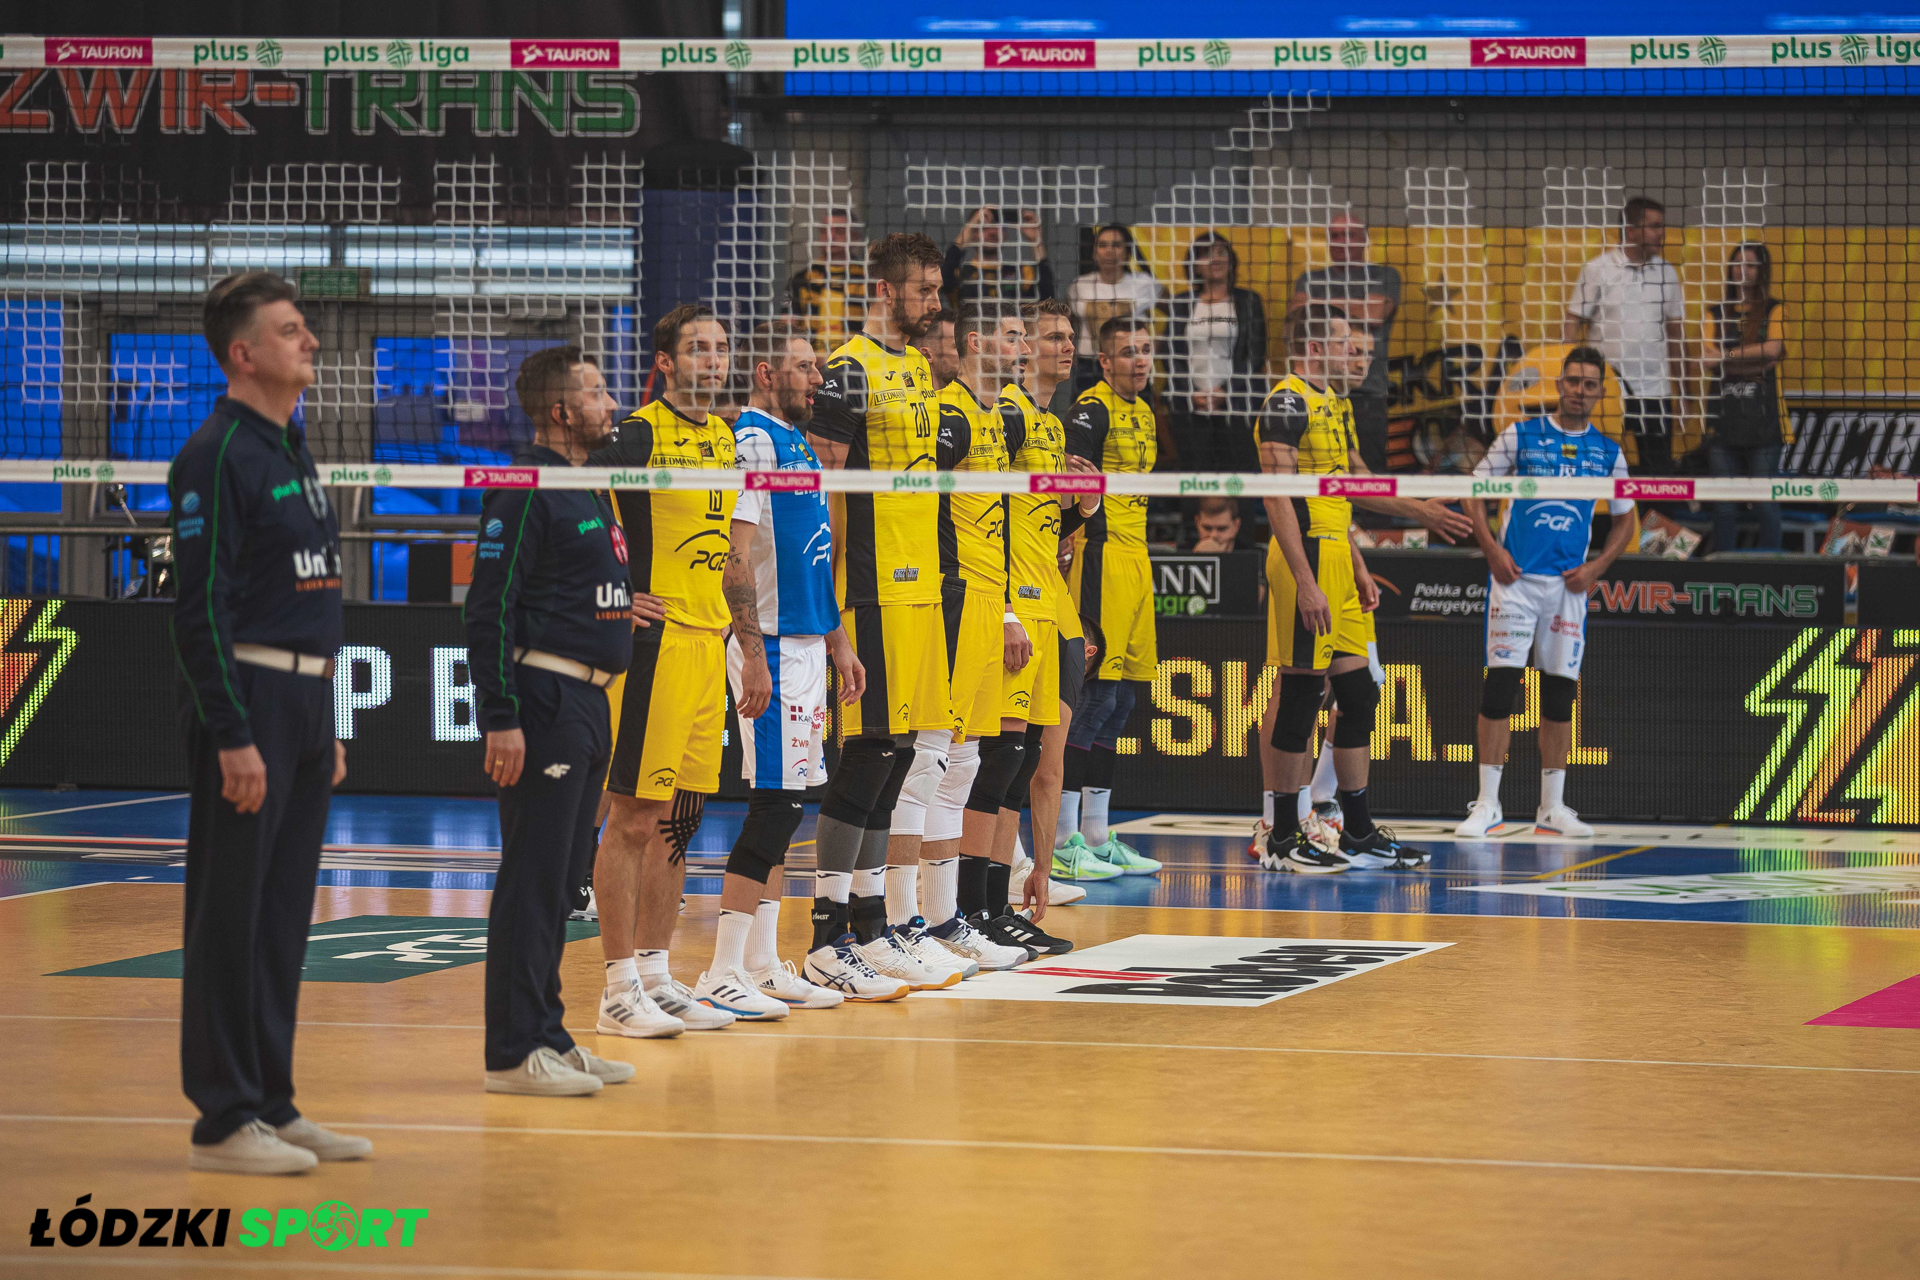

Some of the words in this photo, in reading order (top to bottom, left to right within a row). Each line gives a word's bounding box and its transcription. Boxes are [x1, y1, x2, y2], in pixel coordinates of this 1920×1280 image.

[79, 45, 143, 59] TAURON
[193, 39, 249, 63] plus
[324, 40, 379, 66] plus
[419, 41, 469, 67] liga
[544, 47, 611, 62] TAURON
[661, 41, 718, 67] plus
[793, 41, 850, 67] plus
[891, 41, 942, 67] liga
[1020, 47, 1087, 62] TAURON
[1138, 40, 1195, 67] plus
[1273, 40, 1332, 67] plus
[1375, 39, 1427, 66] liga
[1507, 45, 1576, 60] TAURON
[1630, 37, 1690, 65] plus
[1771, 37, 1832, 65] plus
[921, 388, 937, 401] plus
[910, 402, 930, 438] 20
[53, 464, 91, 483] plus
[330, 467, 369, 484] plus
[488, 472, 533, 484] TAURON
[610, 470, 649, 487] plus
[769, 477, 815, 487] TAURON
[893, 473, 932, 490] plus
[1054, 479, 1100, 490] TAURON
[1180, 477, 1219, 494] plus
[1344, 481, 1391, 492] TAURON
[1472, 480, 1512, 497] plus
[1640, 484, 1688, 495] TAURON
[1772, 482, 1813, 499] plus
[986, 520, 1002, 538] PG
[1039, 516, 1060, 535] PG
[1534, 513, 1574, 532] PGE
[1152, 565, 1213, 594] NN
[1414, 583, 1461, 597] Polska
[654, 776, 675, 787] PGE
